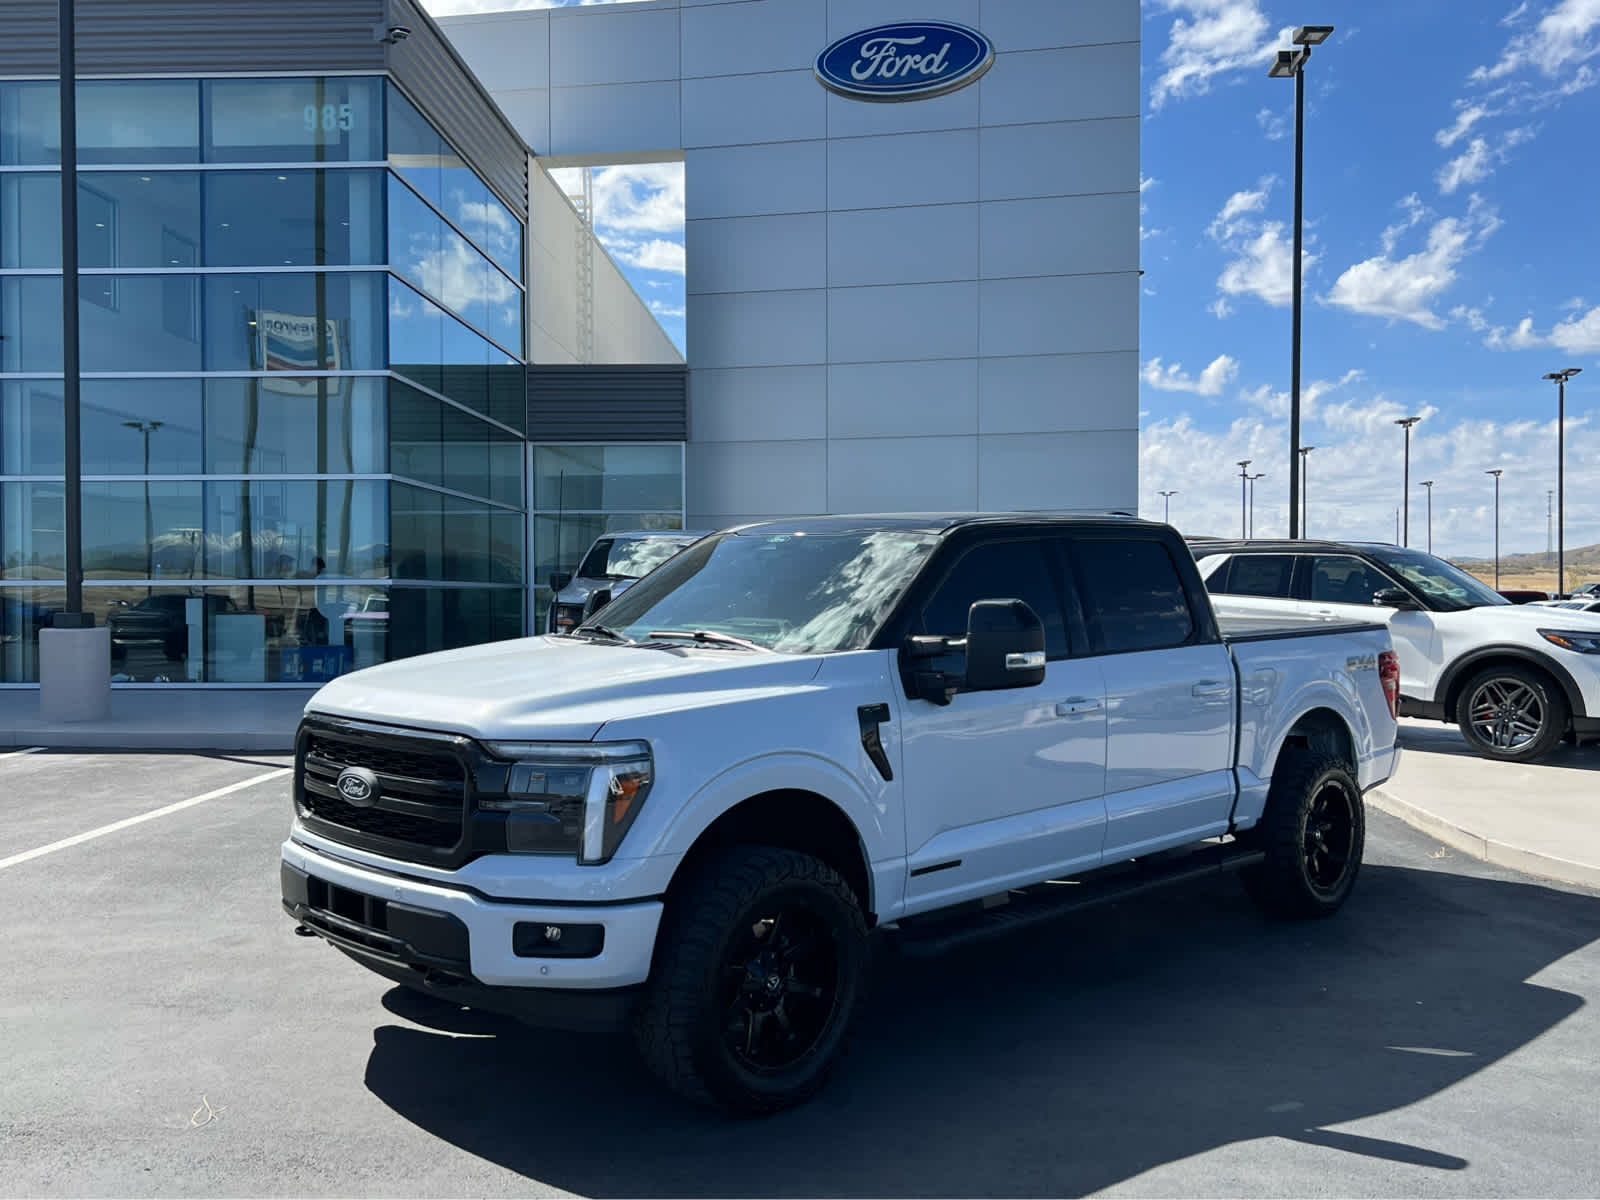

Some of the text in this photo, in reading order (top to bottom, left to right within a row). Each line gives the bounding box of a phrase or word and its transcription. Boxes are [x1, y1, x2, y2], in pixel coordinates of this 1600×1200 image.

[851, 35, 951, 81] Ford
[303, 103, 354, 132] 985
[343, 777, 366, 796] Ford
